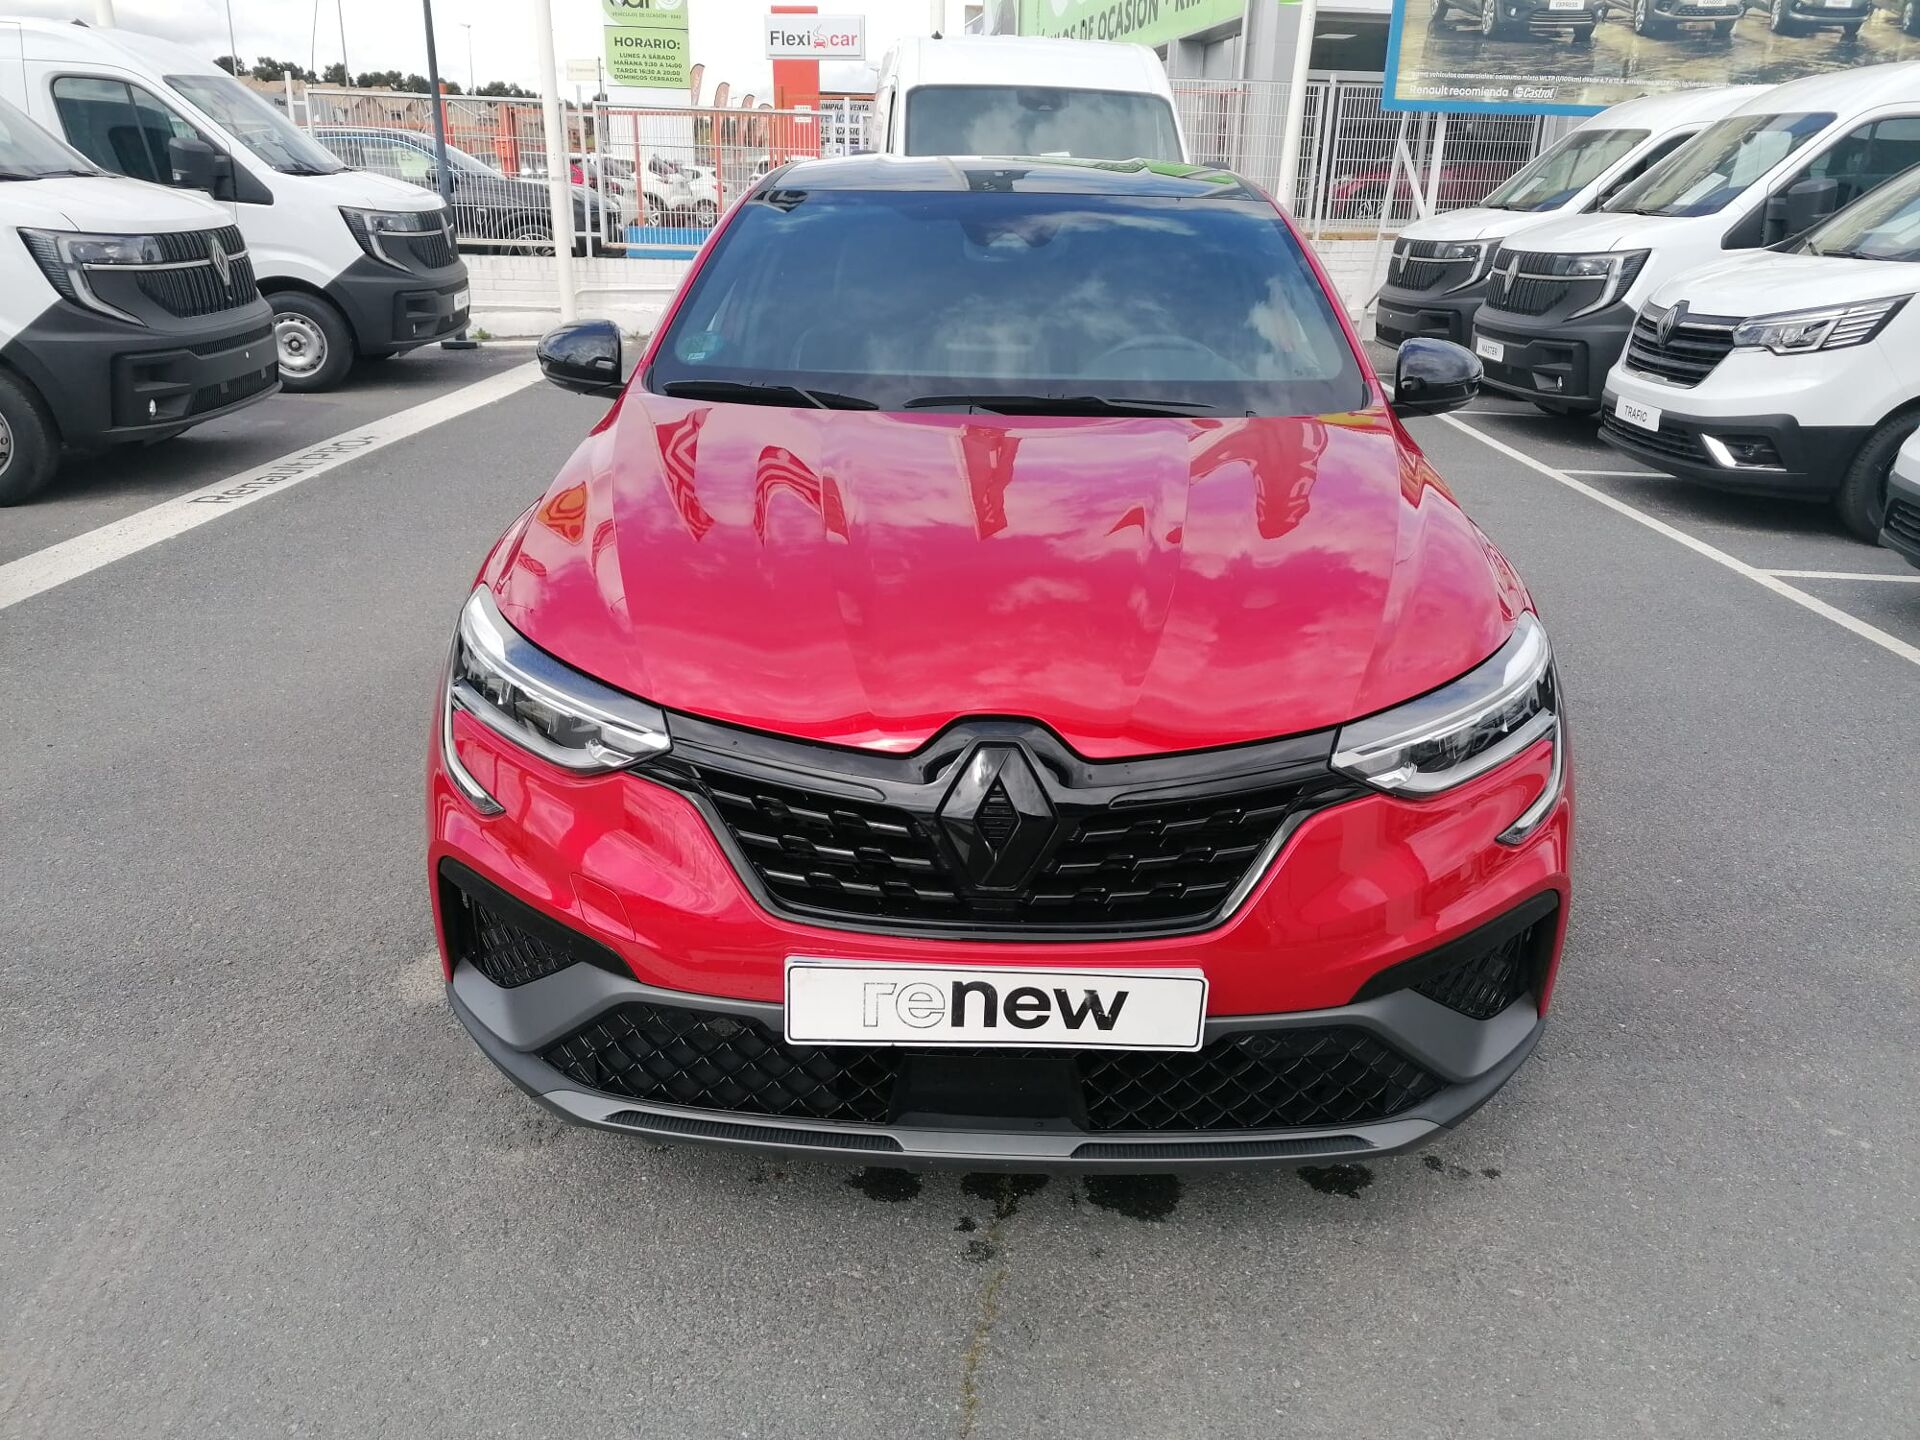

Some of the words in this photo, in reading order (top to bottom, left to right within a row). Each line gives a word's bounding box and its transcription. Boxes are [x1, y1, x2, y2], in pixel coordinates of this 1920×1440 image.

[614, 36, 681, 50] HORARIO:
[770, 30, 811, 46] Flexi
[830, 34, 857, 46] car
[1409, 84, 1449, 96] Renault
[1449, 86, 1509, 97] recomienda
[1523, 87, 1555, 99] Castrol
[1625, 405, 1648, 423] TRAFIC
[186, 460, 322, 504] Renault
[862, 980, 1129, 1031] renew
